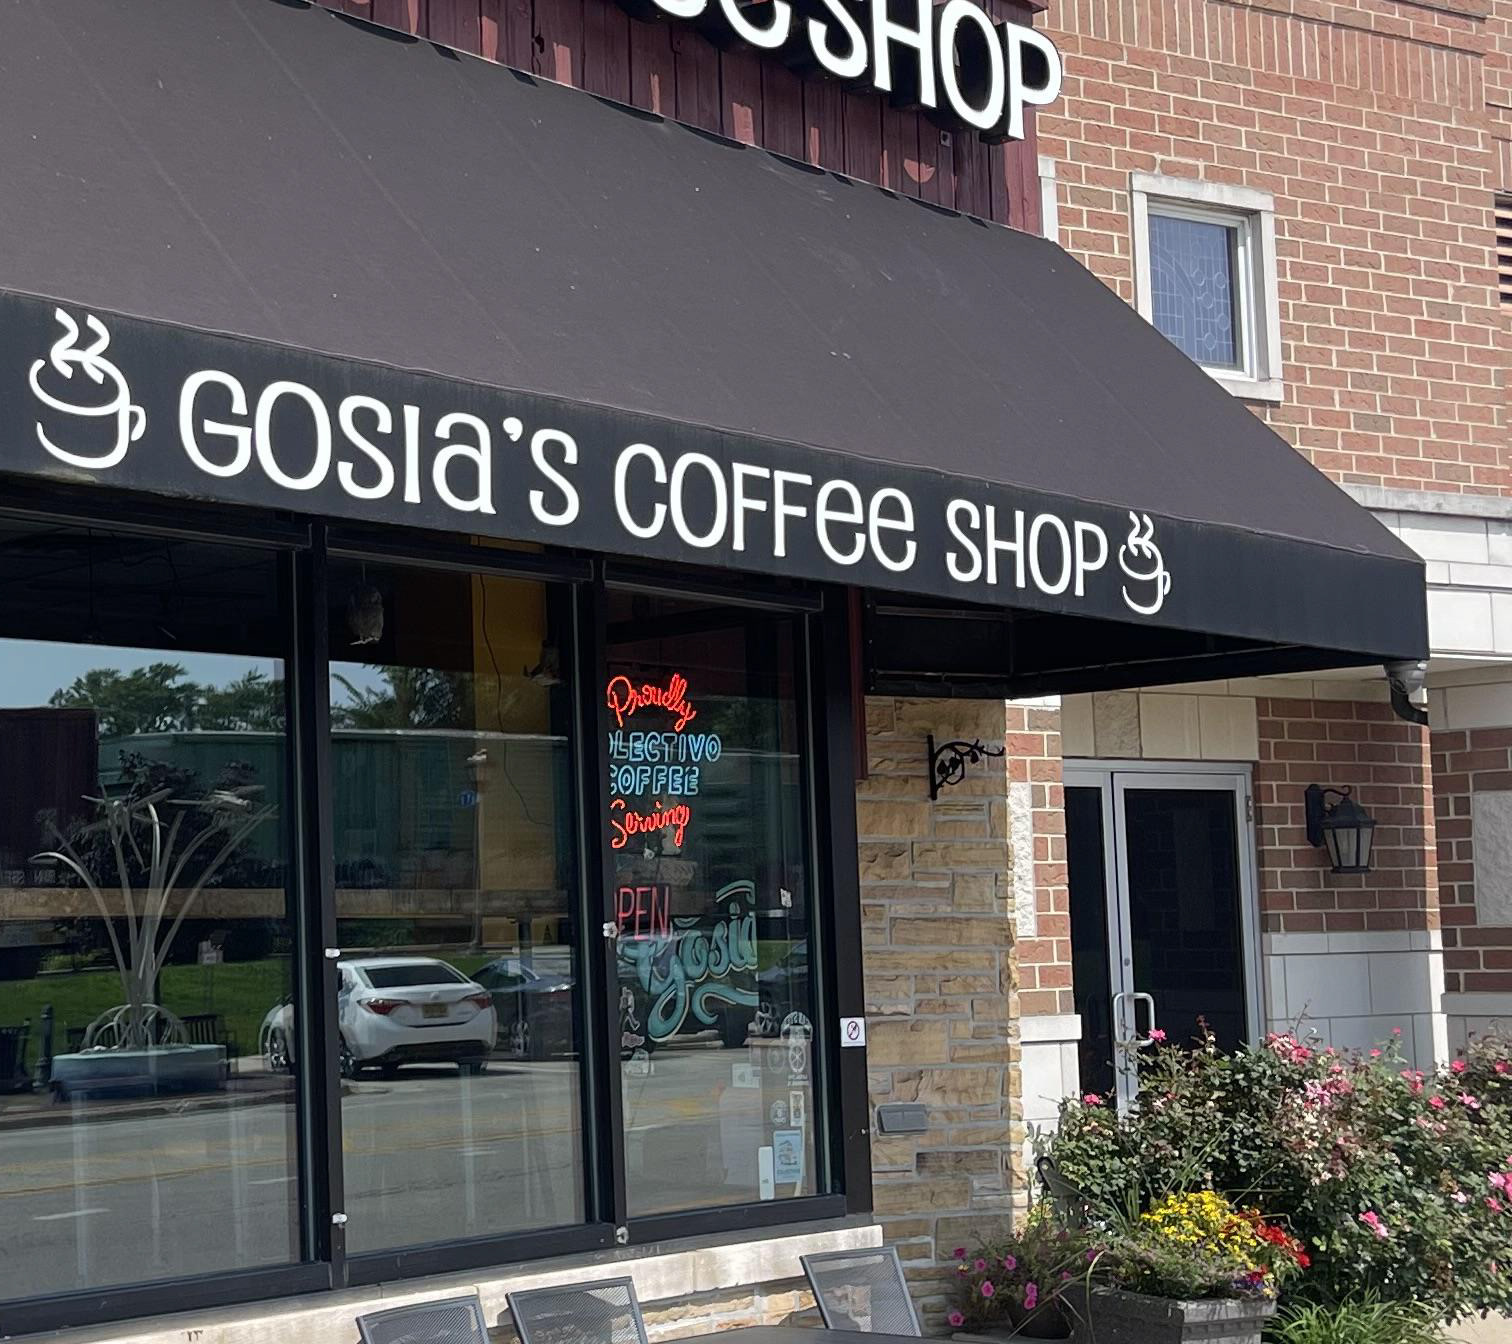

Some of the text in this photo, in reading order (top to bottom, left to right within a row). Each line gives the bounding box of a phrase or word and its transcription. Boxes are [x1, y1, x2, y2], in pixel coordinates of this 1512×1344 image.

[946, 499, 1109, 597] SHOP
[607, 673, 696, 732] Proudly
[609, 730, 721, 762] LECTIVO
[610, 798, 689, 848] Serving
[614, 886, 670, 940] PEN
